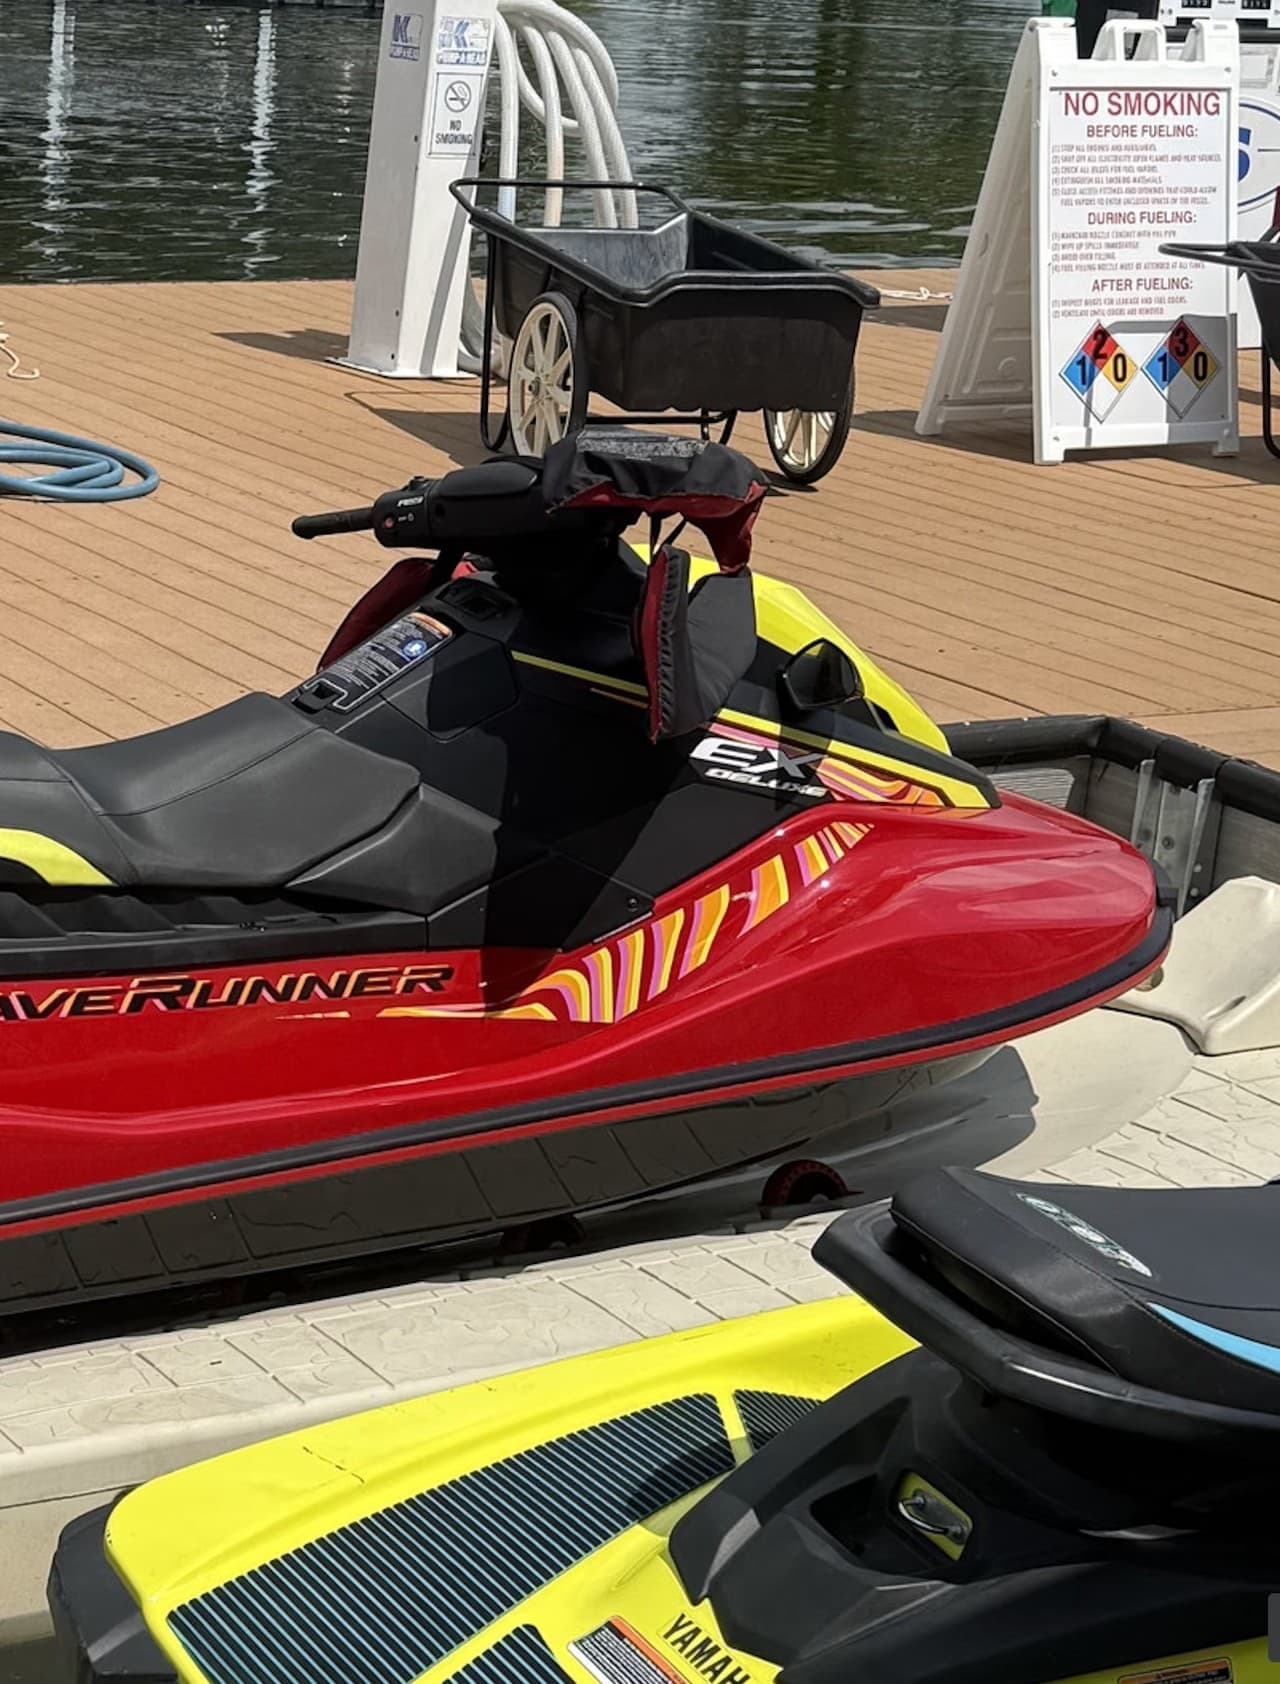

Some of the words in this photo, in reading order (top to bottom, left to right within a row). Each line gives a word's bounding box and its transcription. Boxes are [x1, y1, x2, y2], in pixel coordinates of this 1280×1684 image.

[1064, 92, 1099, 116] NO
[1107, 92, 1220, 116] SMOKING
[435, 132, 473, 144] SMOKING
[449, 120, 462, 131] NO
[1087, 125, 1138, 138] BEFORE
[1141, 124, 1198, 138] FUELING:
[1088, 212, 1136, 225] DURING
[1139, 211, 1197, 224] FUELING:
[1092, 279, 1132, 292] AFTER
[1136, 277, 1193, 291] FUELING:
[1092, 329, 1108, 359] 2
[1172, 327, 1189, 357] 3
[1076, 355, 1087, 386] 1
[1113, 353, 1127, 383] 0
[1158, 351, 1168, 383] 1
[1194, 351, 1208, 381] 0
[689, 737, 824, 779] EX
[704, 768, 830, 798] DELUXE
[662, 1613, 752, 1684] YAMAH
